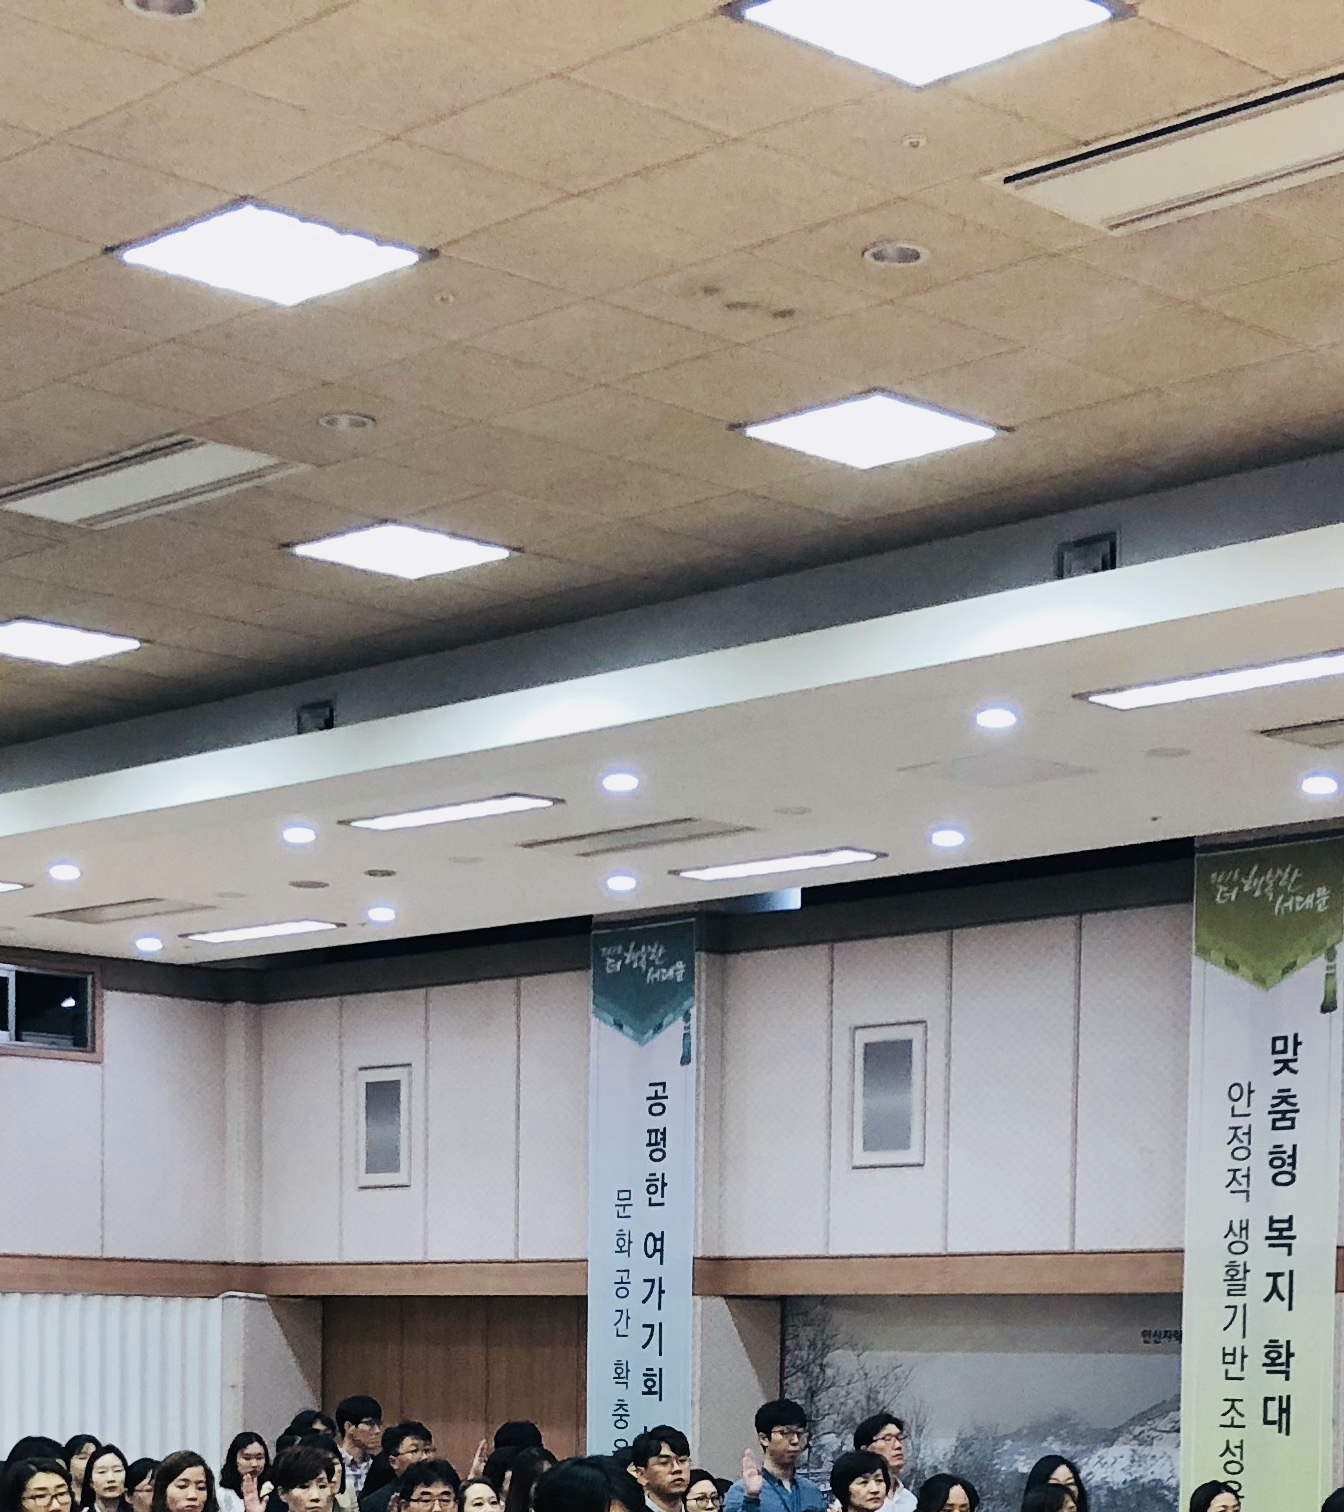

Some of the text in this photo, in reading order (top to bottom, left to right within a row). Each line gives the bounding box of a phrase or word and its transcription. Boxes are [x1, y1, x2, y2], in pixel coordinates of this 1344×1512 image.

[1224, 1080, 1256, 1203] 안정적
[613, 1189, 633, 1338] 문화공간
[641, 1081, 669, 1402] 공평한 여가기회
[1221, 1218, 1251, 1382] 생활기반
[1261, 1032, 1303, 1437] 맞춤형 복지 확대
